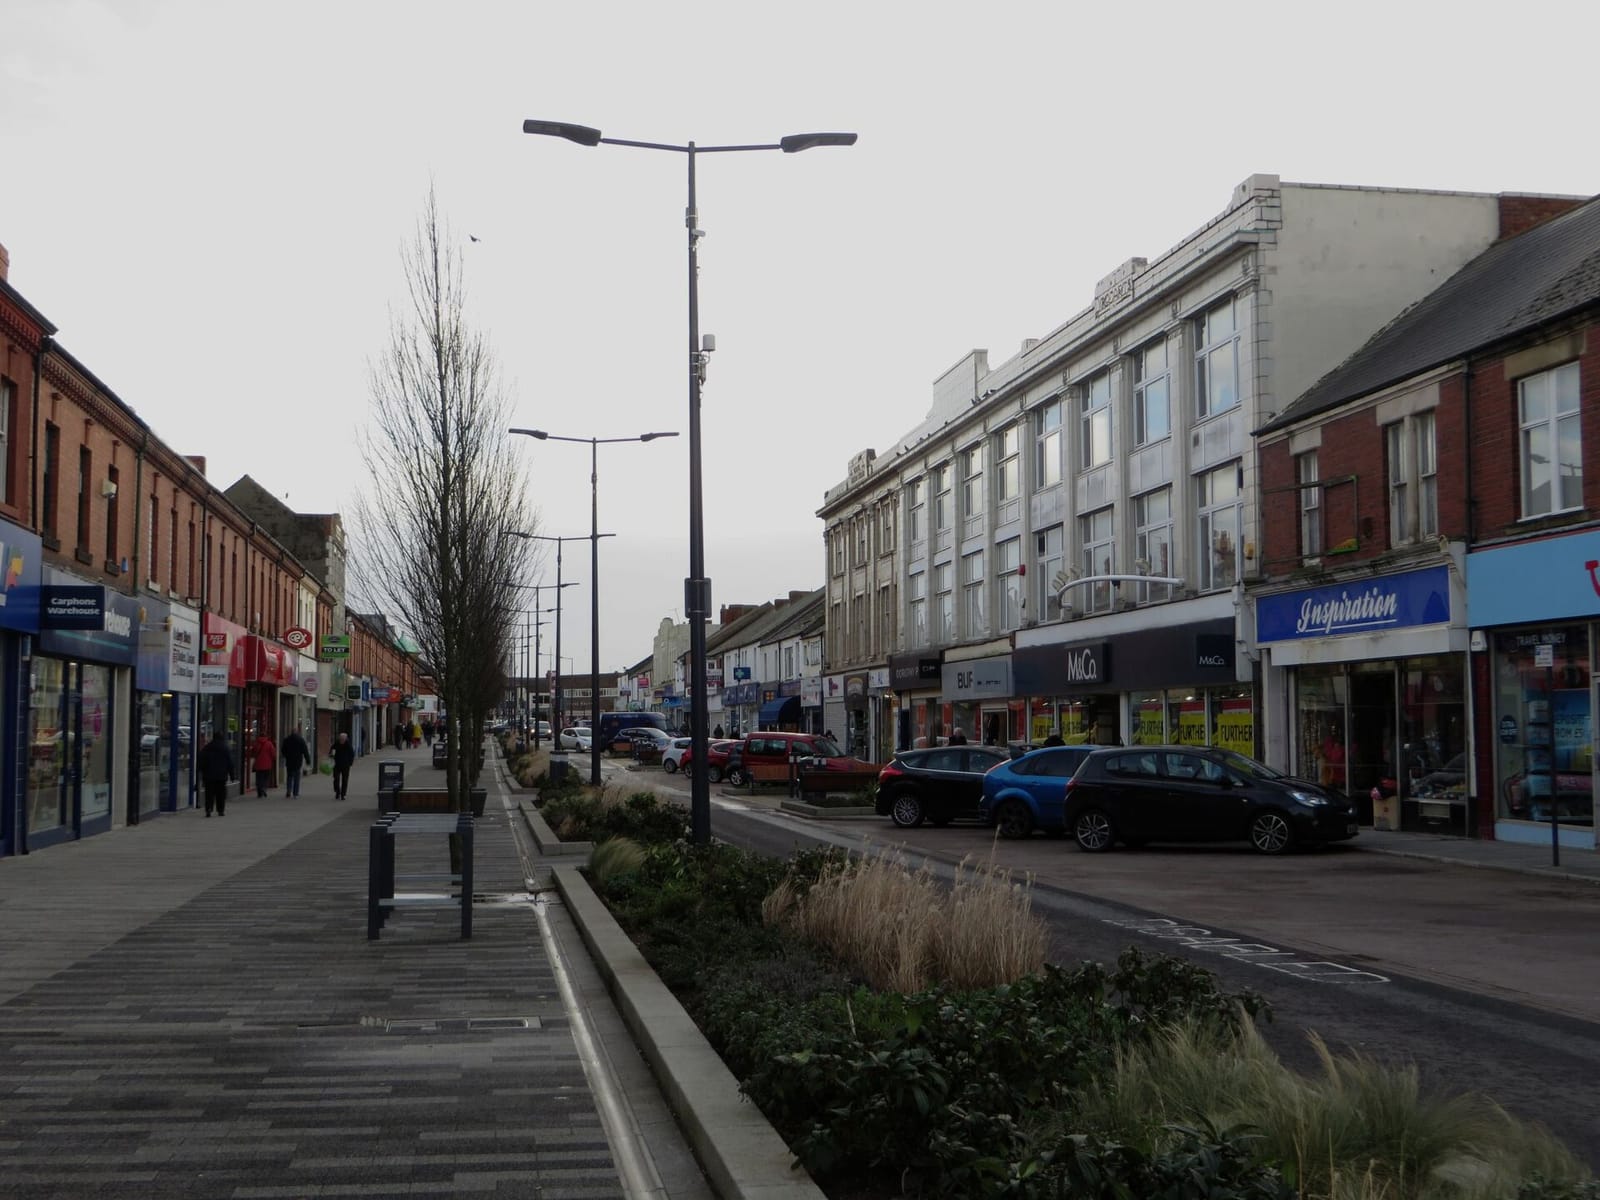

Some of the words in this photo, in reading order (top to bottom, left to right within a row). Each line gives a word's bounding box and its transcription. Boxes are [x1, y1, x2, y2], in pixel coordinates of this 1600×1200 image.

[50, 596, 97, 608] Carphone
[1296, 587, 1398, 634] Inspiration
[47, 606, 101, 616] Warehouse
[1140, 719, 1164, 736] FURTHE
[1181, 723, 1205, 741] FURTHE
[1220, 724, 1253, 742] FURTHER
